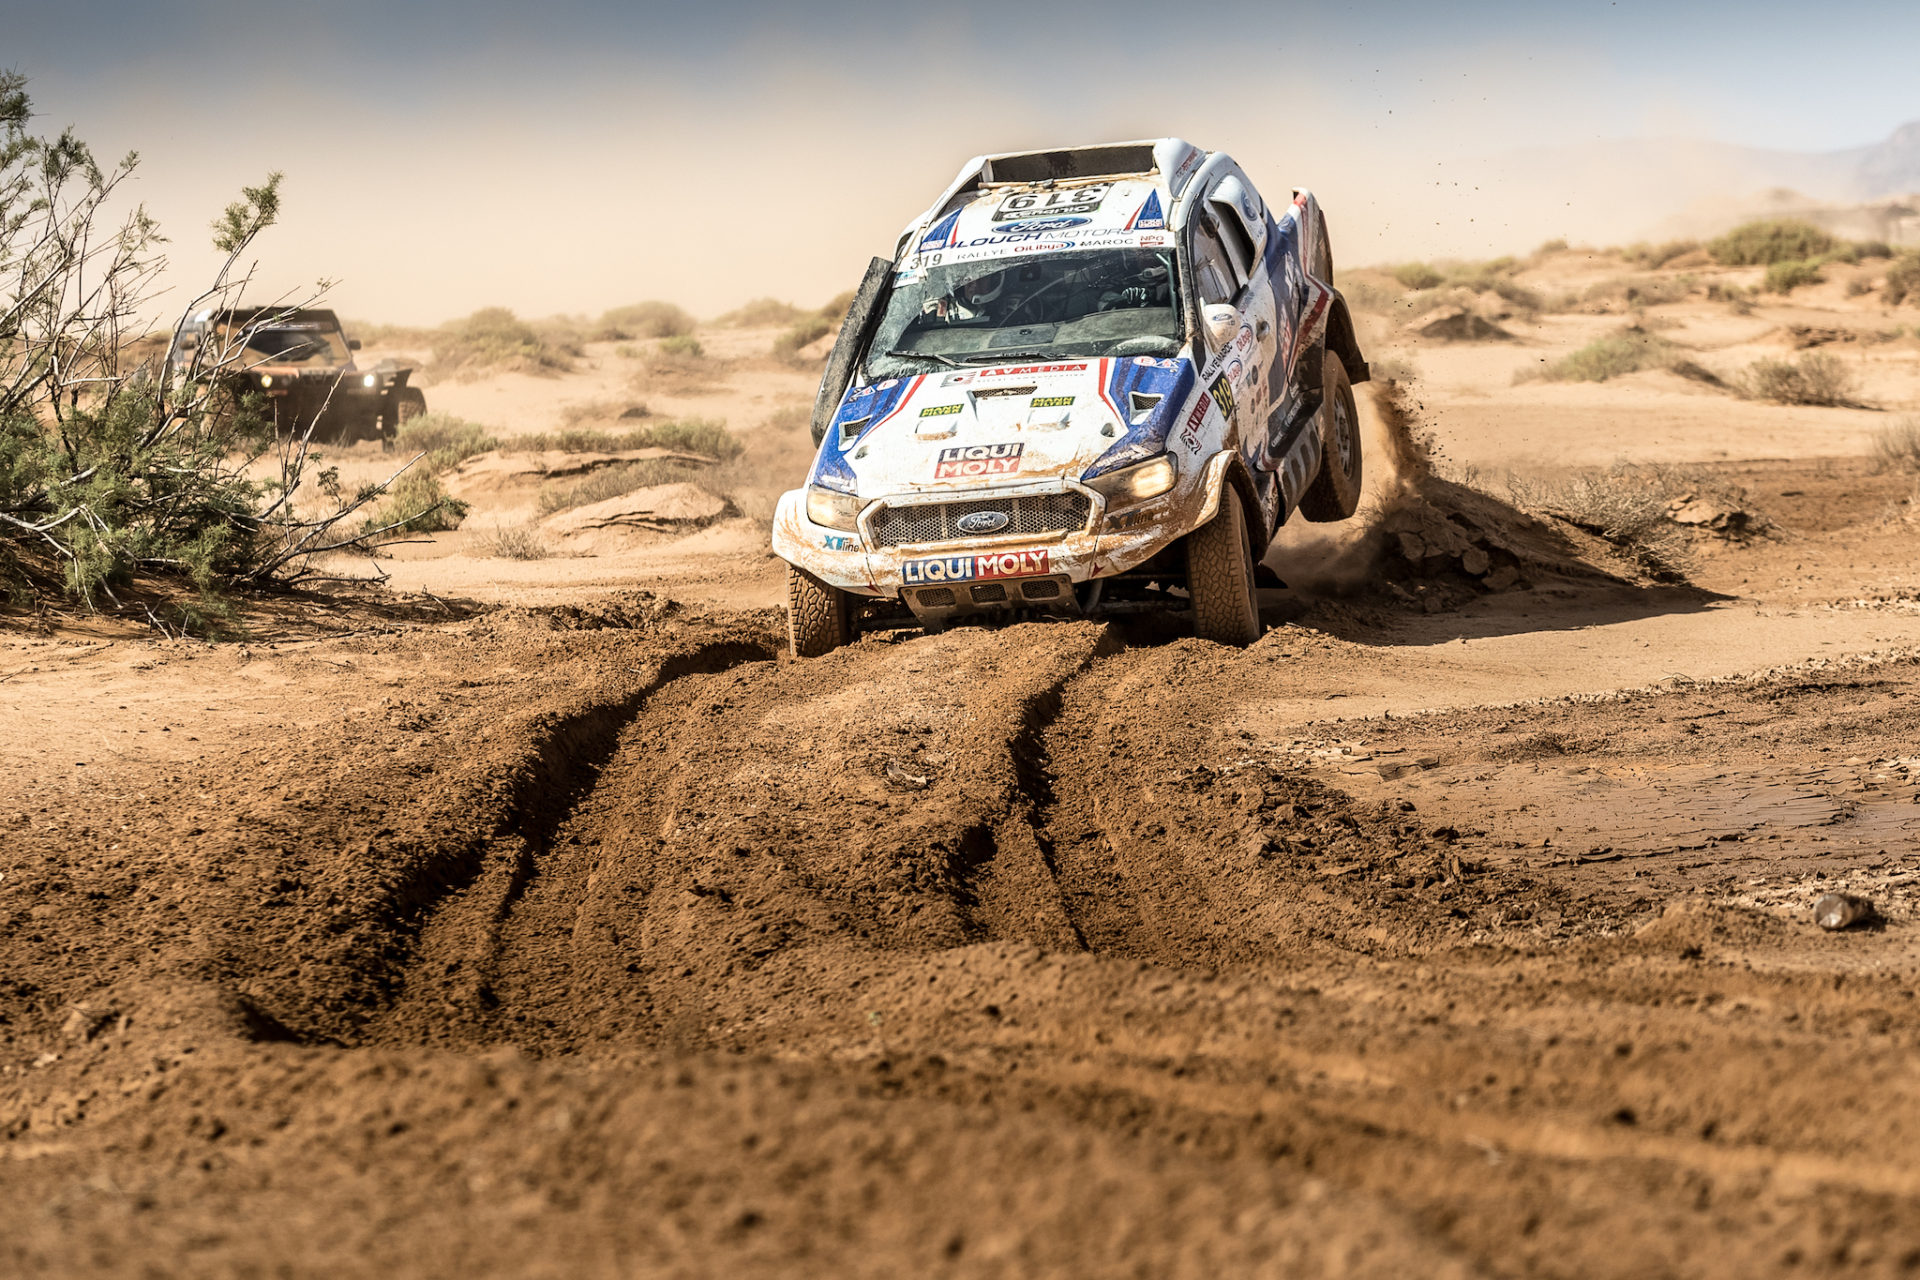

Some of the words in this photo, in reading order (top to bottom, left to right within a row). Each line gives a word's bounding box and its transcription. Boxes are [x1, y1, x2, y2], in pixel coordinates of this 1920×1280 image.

[1008, 188, 1102, 209] 319
[1010, 218, 1073, 232] Ford
[1045, 228, 1134, 239] MOTORS
[957, 249, 1008, 260] RALLYE
[1014, 243, 1064, 253] OiLibya
[1080, 238, 1134, 247] MAROC
[909, 253, 943, 270] 319
[1201, 358, 1221, 382] RALLYE
[1216, 341, 1233, 363] MAROC
[1213, 377, 1233, 417] 319
[942, 443, 1020, 462] LIQUI
[937, 457, 1018, 478] MOLY
[968, 515, 996, 529] Ford
[823, 535, 859, 552] XTline
[905, 557, 973, 581] LIQUI
[977, 551, 1046, 576] MOLY
